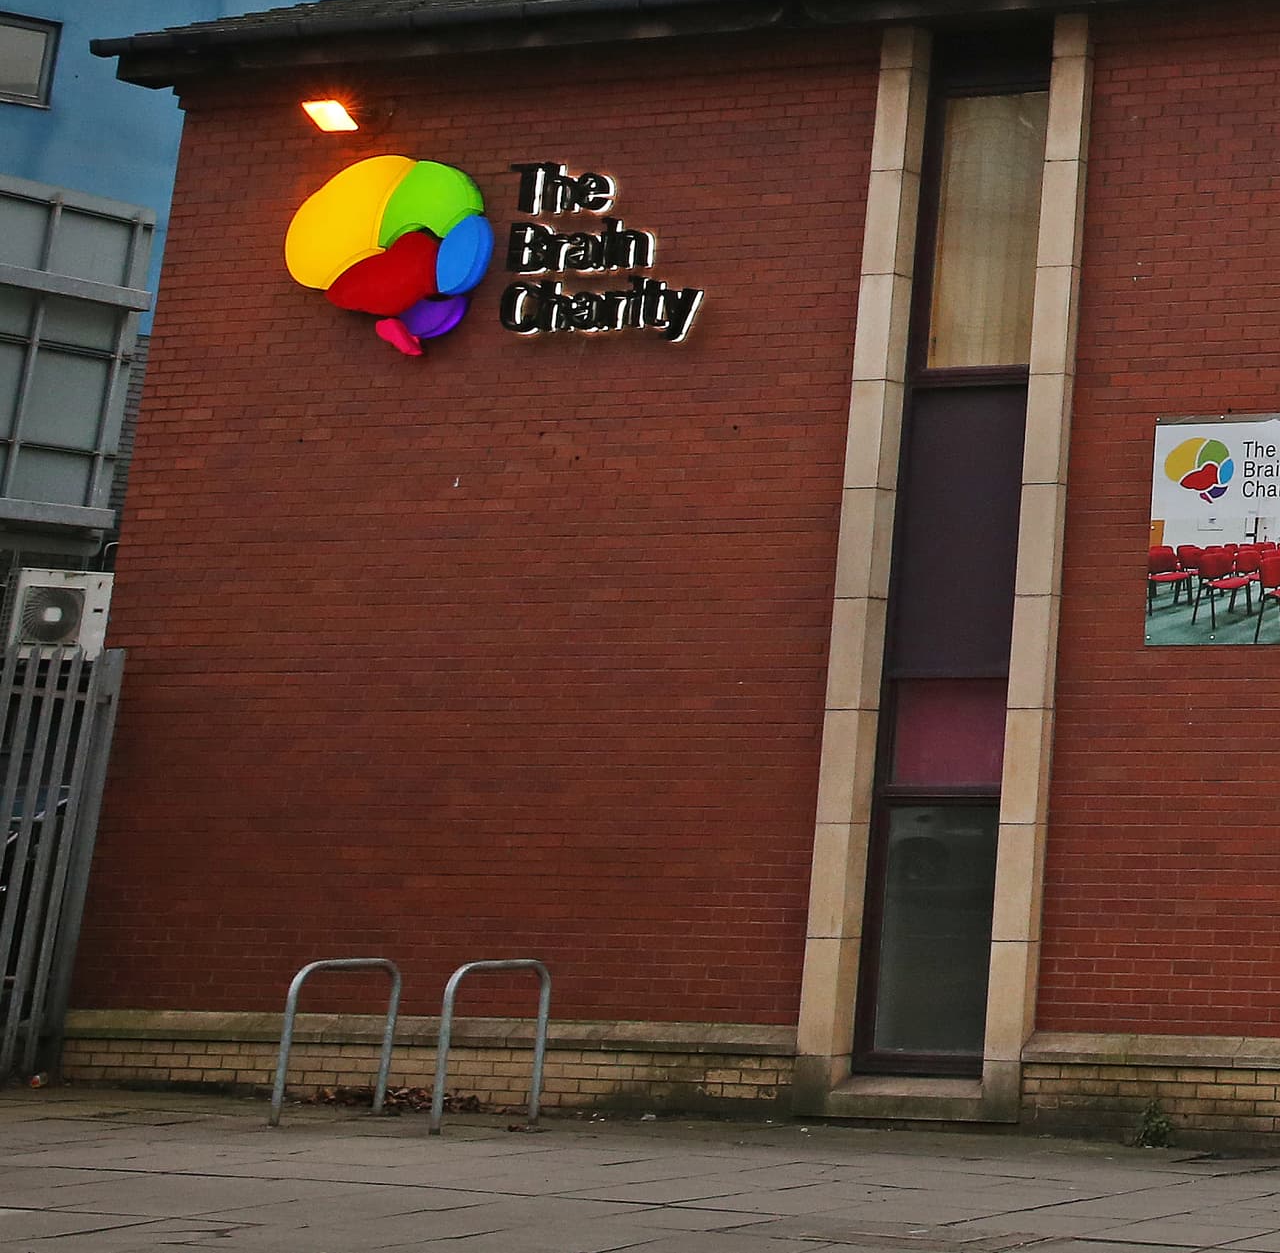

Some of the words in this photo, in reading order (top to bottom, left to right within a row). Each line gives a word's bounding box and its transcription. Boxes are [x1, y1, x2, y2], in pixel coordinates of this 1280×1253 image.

[511, 162, 617, 216] The
[508, 219, 656, 275] Brain
[502, 276, 704, 343] Charity
[1243, 441, 1276, 458] The
